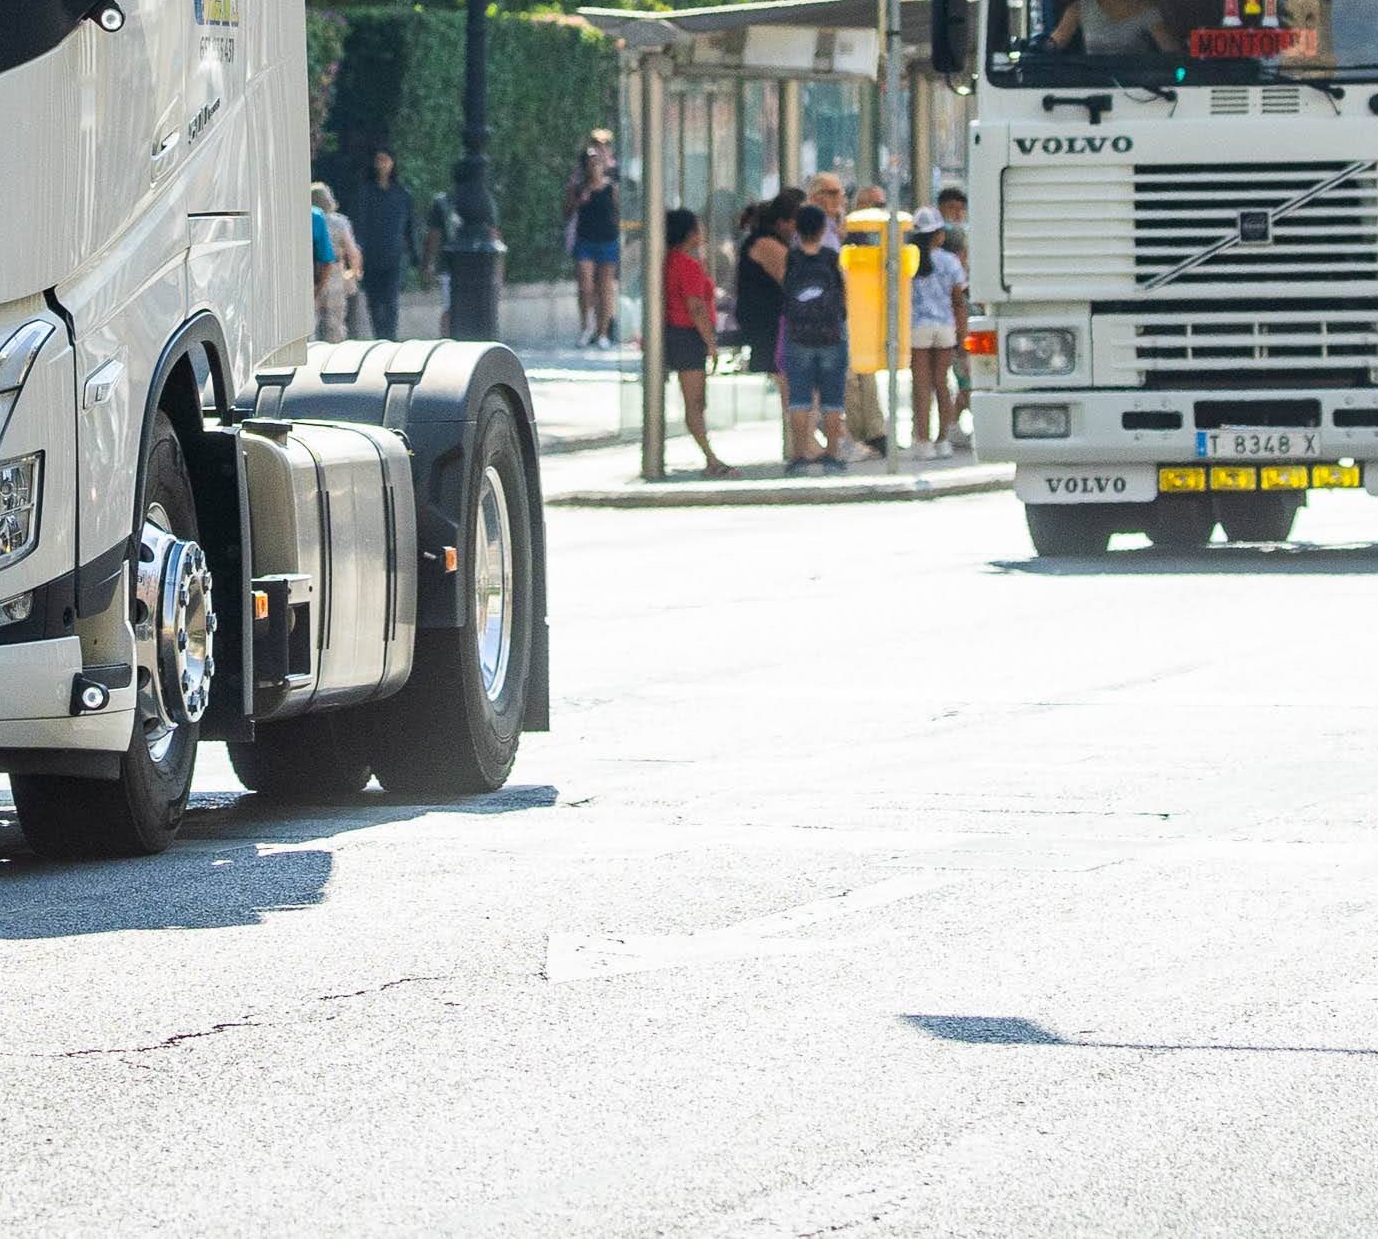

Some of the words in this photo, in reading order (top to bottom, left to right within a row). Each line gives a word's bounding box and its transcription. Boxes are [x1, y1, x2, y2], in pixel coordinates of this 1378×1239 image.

[1013, 136, 1133, 154] VOLVO
[1209, 435, 1219, 454] T
[1235, 435, 1291, 454] 8348
[1304, 434, 1316, 455] X
[1046, 477, 1127, 493] VOLVO
